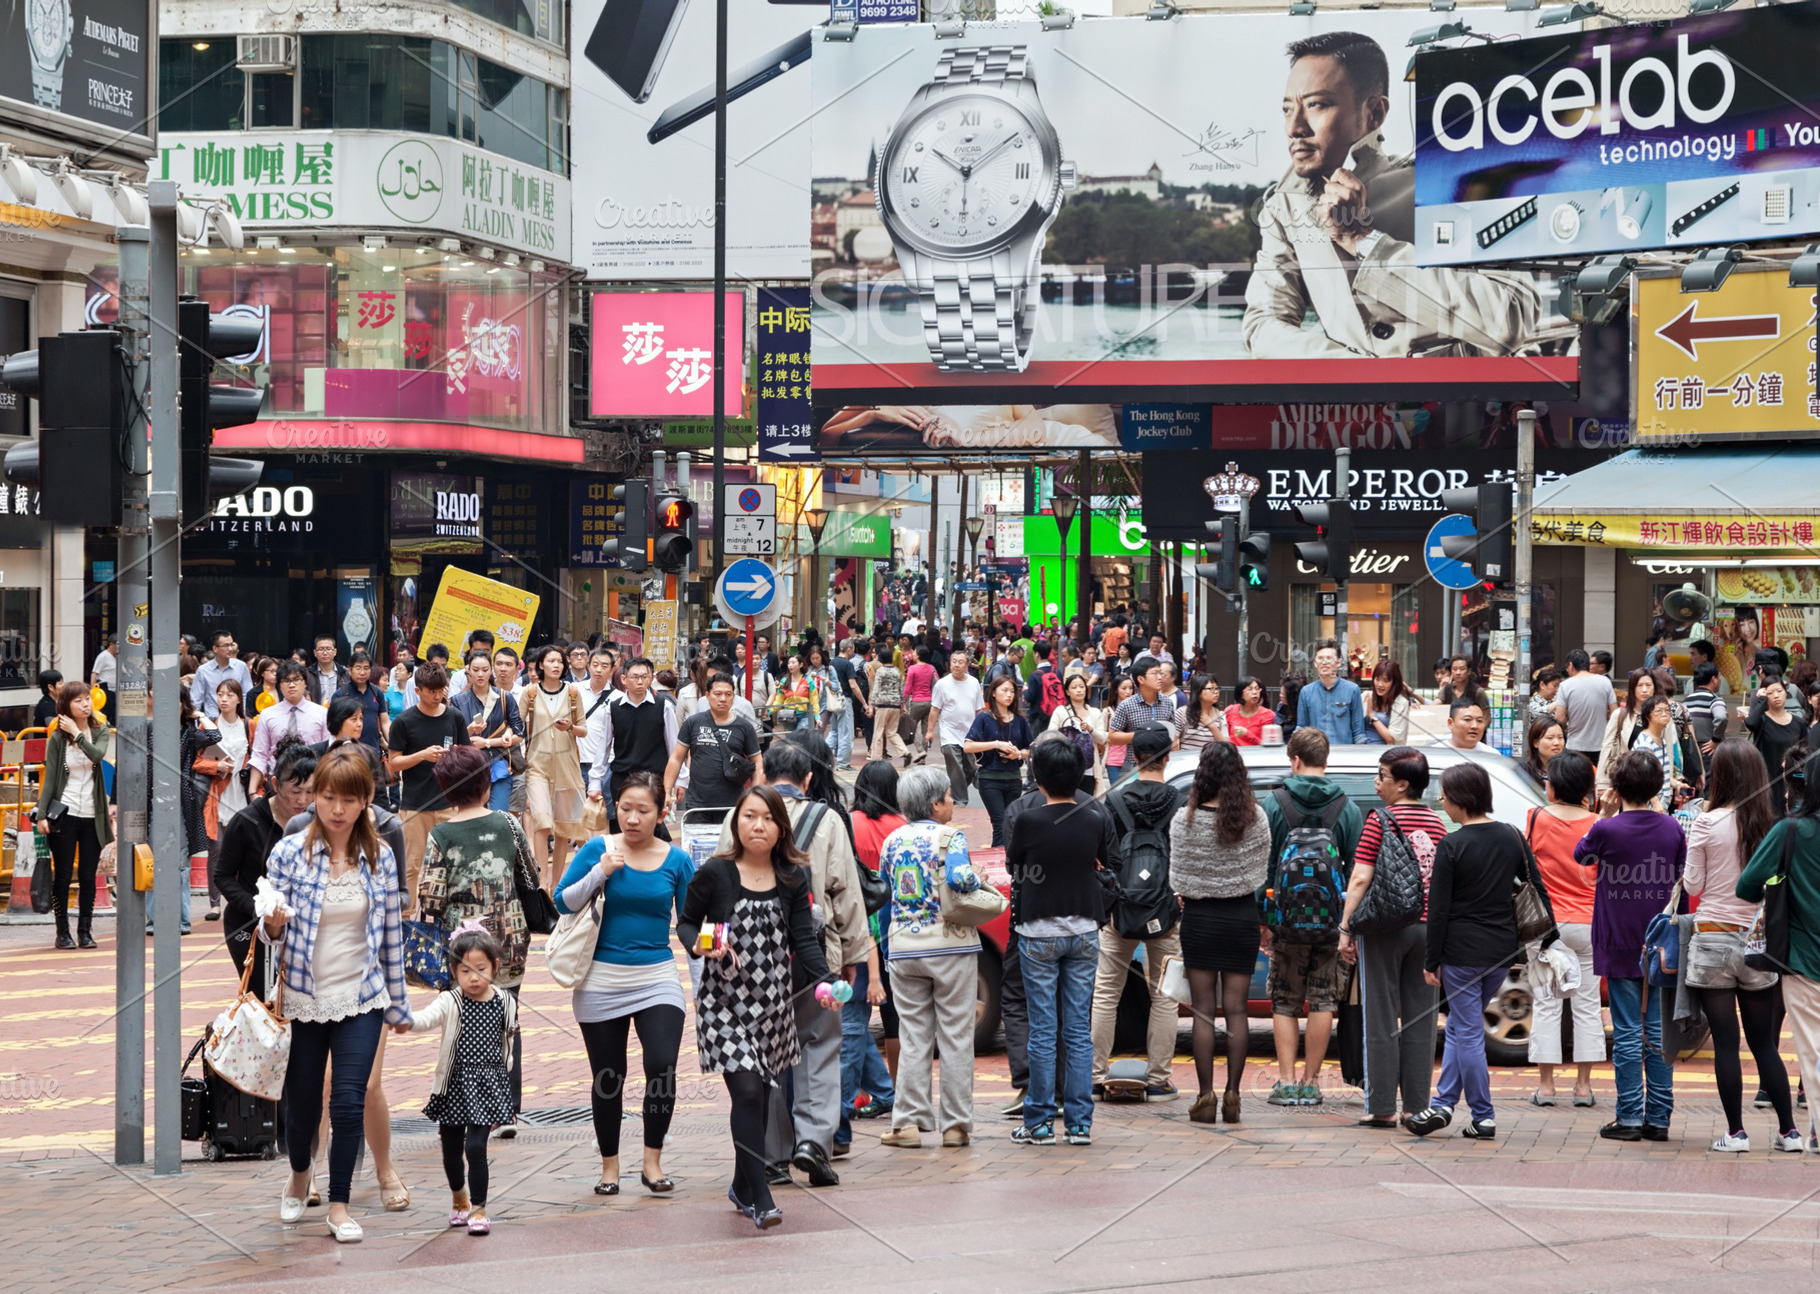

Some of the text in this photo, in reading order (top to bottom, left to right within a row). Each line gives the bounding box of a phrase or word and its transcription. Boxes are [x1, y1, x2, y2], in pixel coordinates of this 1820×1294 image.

[860, 5, 917, 17] 9699 2348
[1432, 33, 1736, 152] acelab
[1600, 133, 1736, 166] technology
[1189, 162, 1241, 172] Zhang Hanyu
[461, 203, 555, 251] ALADIN MESS
[622, 322, 712, 395] 莎莎
[1655, 373, 1784, 410] 行前一分鐘
[1130, 410, 1200, 423] The Hong Kong
[1273, 404, 1395, 423] AMBITIOUS
[1137, 426, 1192, 439] Jockey Club
[1270, 420, 1412, 450] DRAGON
[213, 486, 313, 518] ADO
[436, 491, 480, 522] RADO
[436, 524, 480, 537] SWITZERLAND
[732, 523, 748, 531] 上午
[756, 518, 765, 531] 7
[726, 537, 772, 552] midnight 12
[732, 544, 748, 552] 午夜
[501, 625, 521, 639] $38
